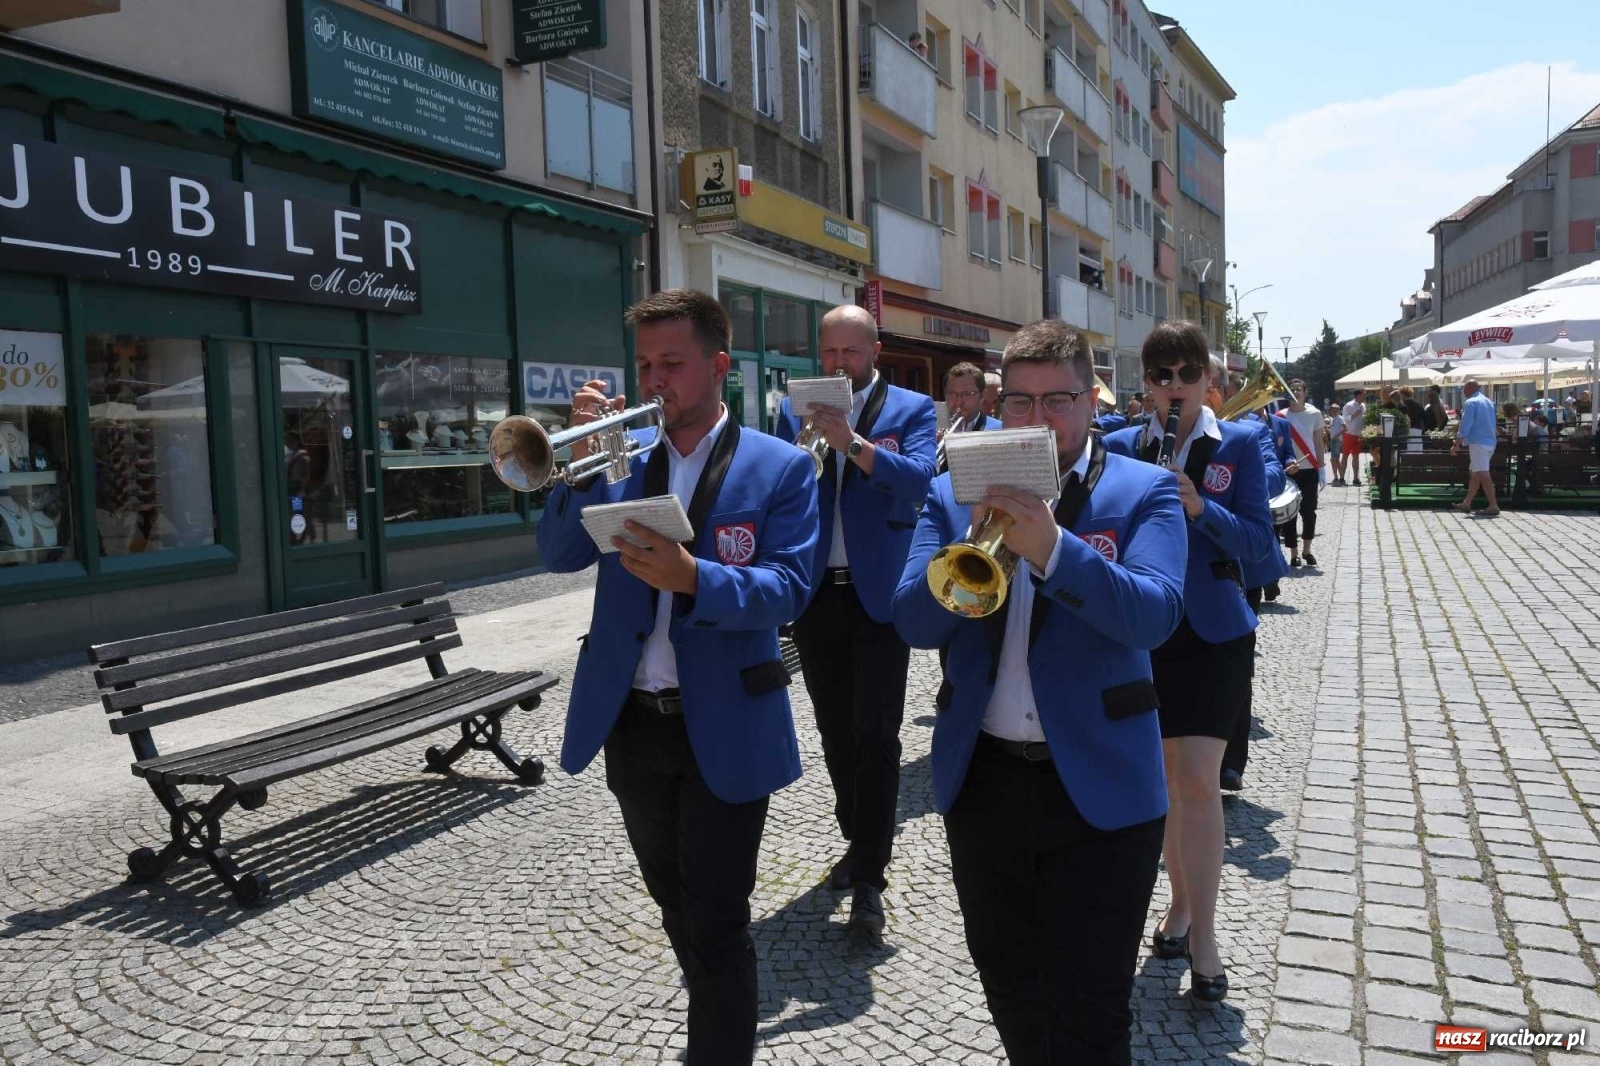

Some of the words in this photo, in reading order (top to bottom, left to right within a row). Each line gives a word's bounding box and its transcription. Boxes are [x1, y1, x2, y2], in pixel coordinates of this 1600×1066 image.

[529, 10, 553, 20] Stefan
[554, 3, 582, 16] Zientek
[538, 14, 576, 28] ADWOKAT
[525, 33, 556, 44] Barbara
[557, 25, 590, 38] Gniewek
[539, 38, 577, 51] ADWOKAT
[342, 30, 425, 73] KANCELARIE
[427, 63, 499, 100] ADWOKACKIE
[353, 77, 391, 96] ADWOKAT
[403, 78, 430, 95] Barbara
[416, 97, 446, 113] ADWOKAT
[464, 114, 494, 129] ADWOKAT
[0, 142, 416, 271] JUBILER
[708, 194, 732, 204] KASY
[126, 246, 202, 276] 1989
[308, 268, 344, 295] M.
[347, 268, 418, 307] Karpisz
[2, 344, 29, 366] do
